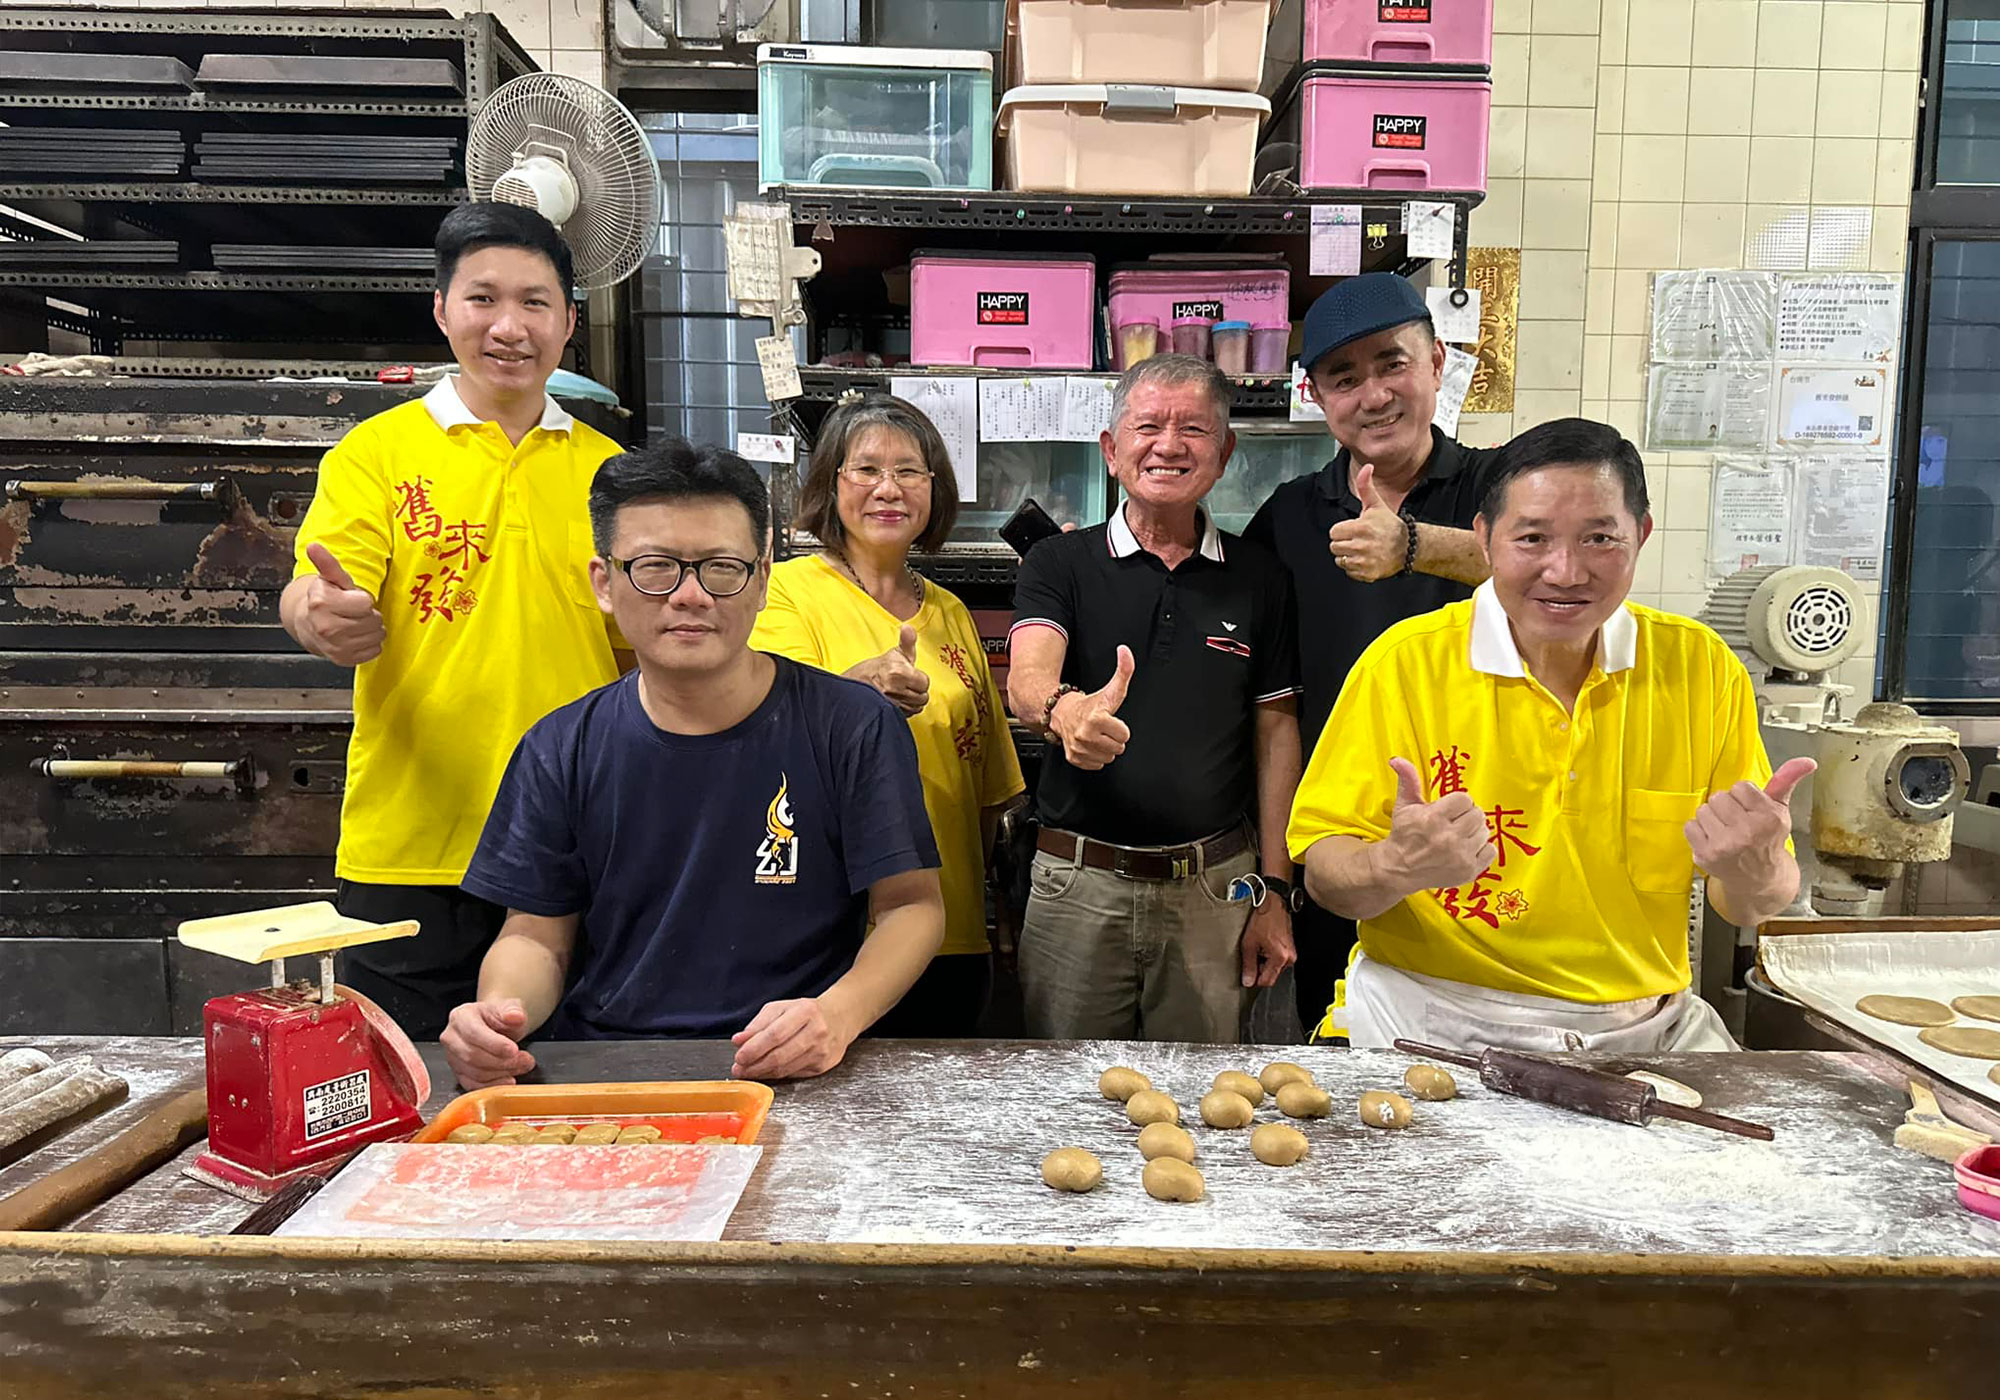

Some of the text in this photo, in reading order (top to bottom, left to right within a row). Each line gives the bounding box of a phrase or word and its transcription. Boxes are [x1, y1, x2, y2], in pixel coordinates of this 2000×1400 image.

[1376, 117, 1423, 133] HAPPY
[980, 294, 1025, 309] HAPPY
[1175, 303, 1220, 317] HAPPY
[321, 1085, 366, 1106] 2220354
